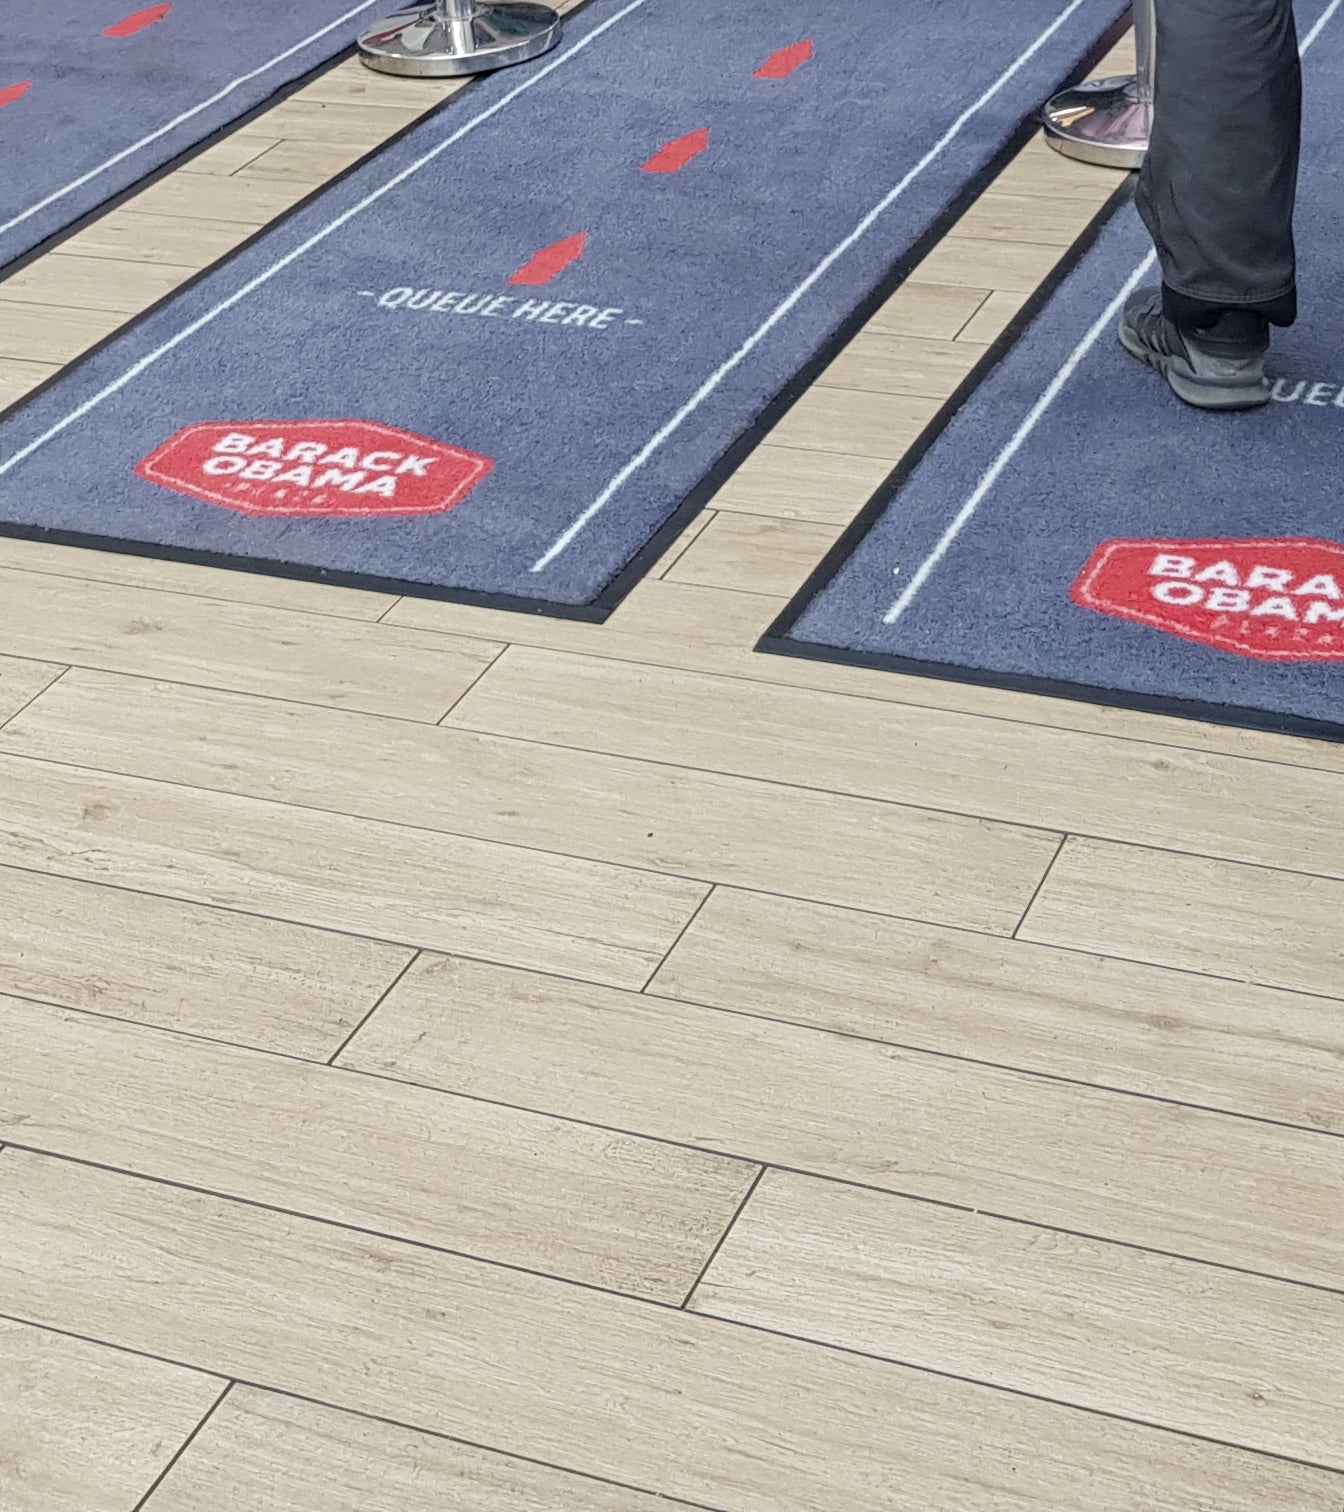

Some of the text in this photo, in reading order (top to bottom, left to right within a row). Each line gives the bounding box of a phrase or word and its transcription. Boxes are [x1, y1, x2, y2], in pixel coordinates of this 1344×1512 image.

[377, 287, 623, 329] QUEUE HERE
[213, 432, 440, 476] BARACK
[202, 455, 398, 497] OBAMA
